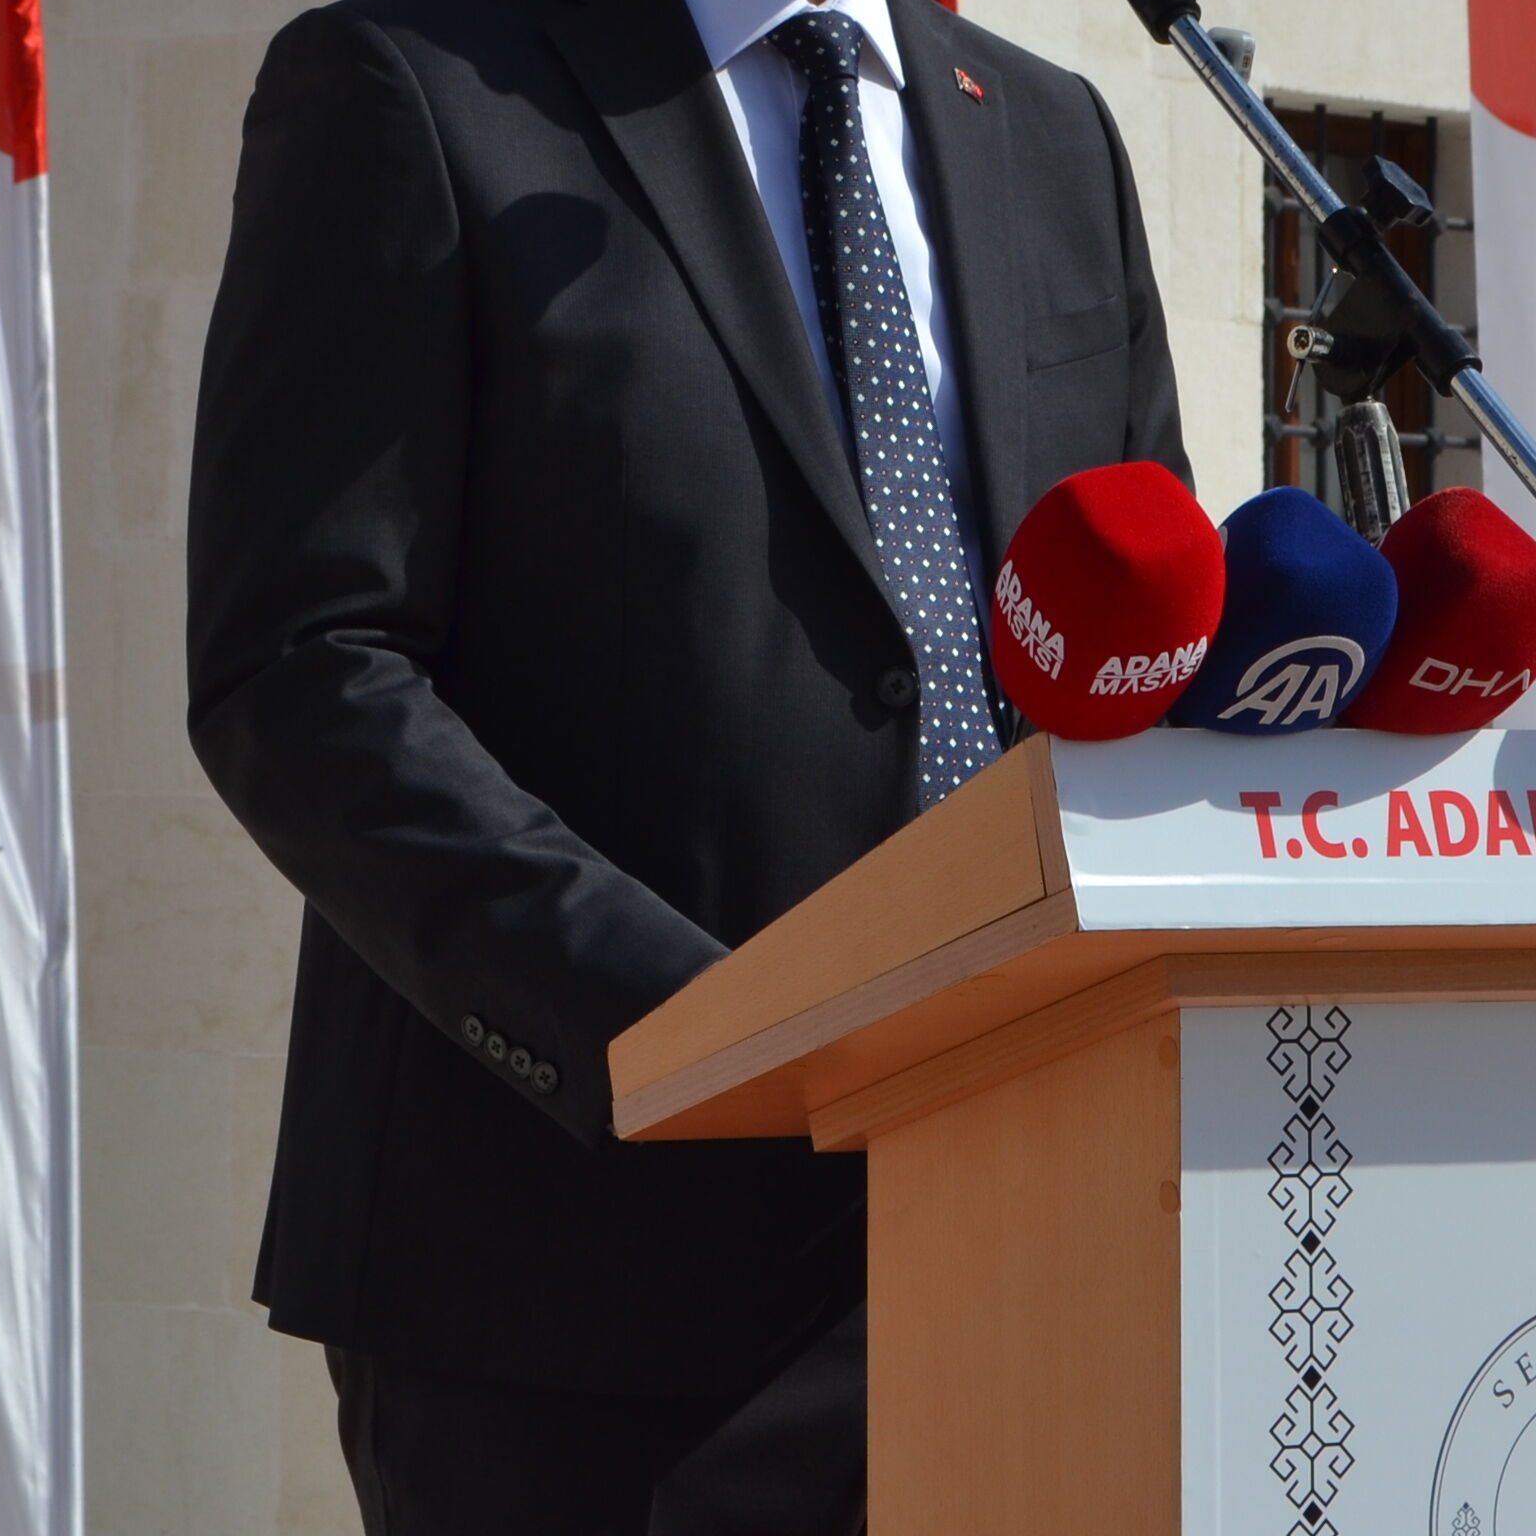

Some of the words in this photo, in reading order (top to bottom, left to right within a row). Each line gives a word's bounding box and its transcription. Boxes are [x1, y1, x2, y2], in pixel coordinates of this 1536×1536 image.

[996, 560, 1064, 662] ADANA
[1095, 636, 1208, 677] ADANA
[1216, 663, 1340, 725] AA
[1239, 790, 1369, 861] T.C.
